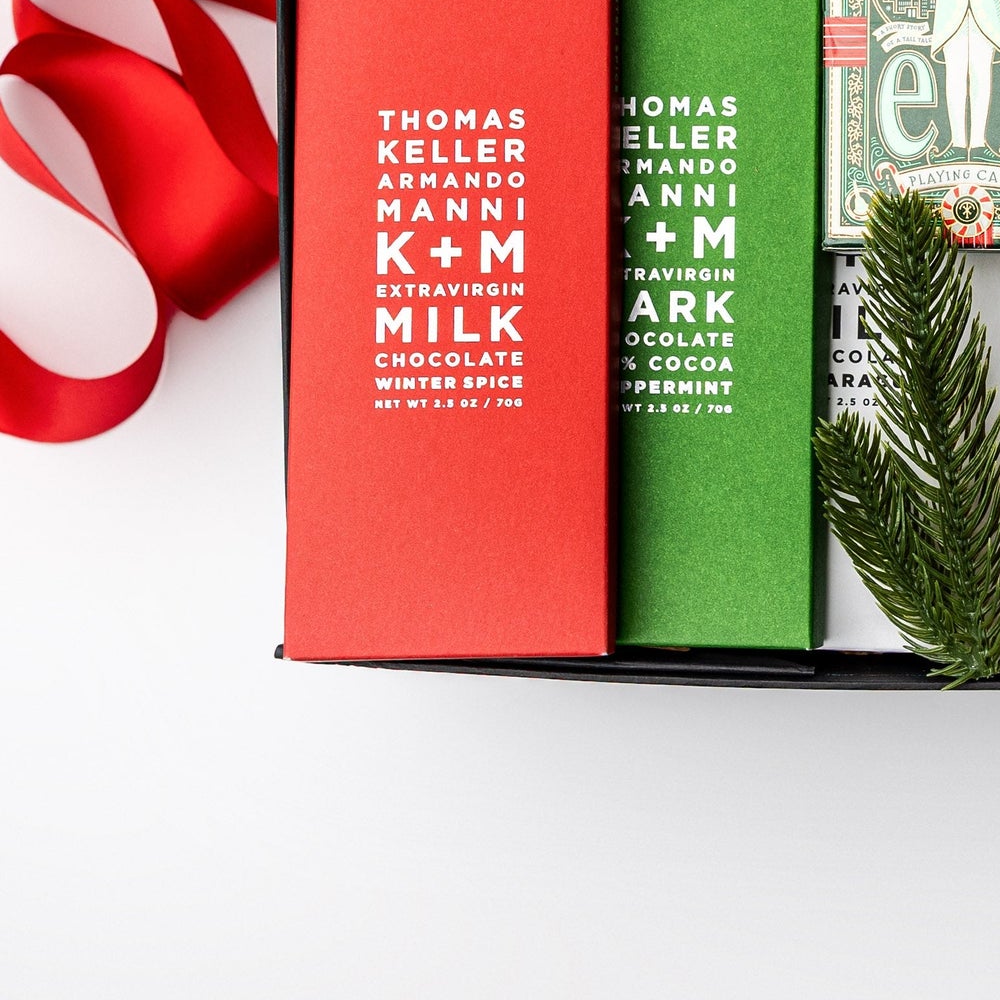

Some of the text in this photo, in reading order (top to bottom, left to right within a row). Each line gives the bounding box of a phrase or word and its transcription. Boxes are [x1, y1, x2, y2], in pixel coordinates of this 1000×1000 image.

[620, 96, 738, 117] HOMAS
[378, 108, 526, 131] THOMAS
[622, 125, 738, 150] ELLER
[378, 138, 526, 164] KELLER
[619, 158, 737, 175] RMANDO
[378, 171, 526, 190] ARMANDO
[909, 169, 970, 187] PLAYING
[627, 183, 736, 208] ANNI
[377, 197, 525, 222] MANNI
[623, 267, 735, 281] TRAVIRGIN
[376, 282, 524, 298] EXTRAVIRGIN
[627, 290, 735, 323] ARK
[375, 305, 523, 344] MILK
[832, 305, 881, 339] IL
[624, 332, 734, 347] OCOLATE
[374, 351, 523, 368] CHOCOLATE
[648, 355, 734, 372] COCOA
[374, 375, 523, 391] WINTER SPICE
[620, 380, 733, 395] PPERMINT
[374, 398, 523, 409] NET WT 2.5 OZ / 70G
[647, 403, 667, 413] 2.5
[673, 403, 690, 413] OZ
[707, 403, 733, 413] 70G
